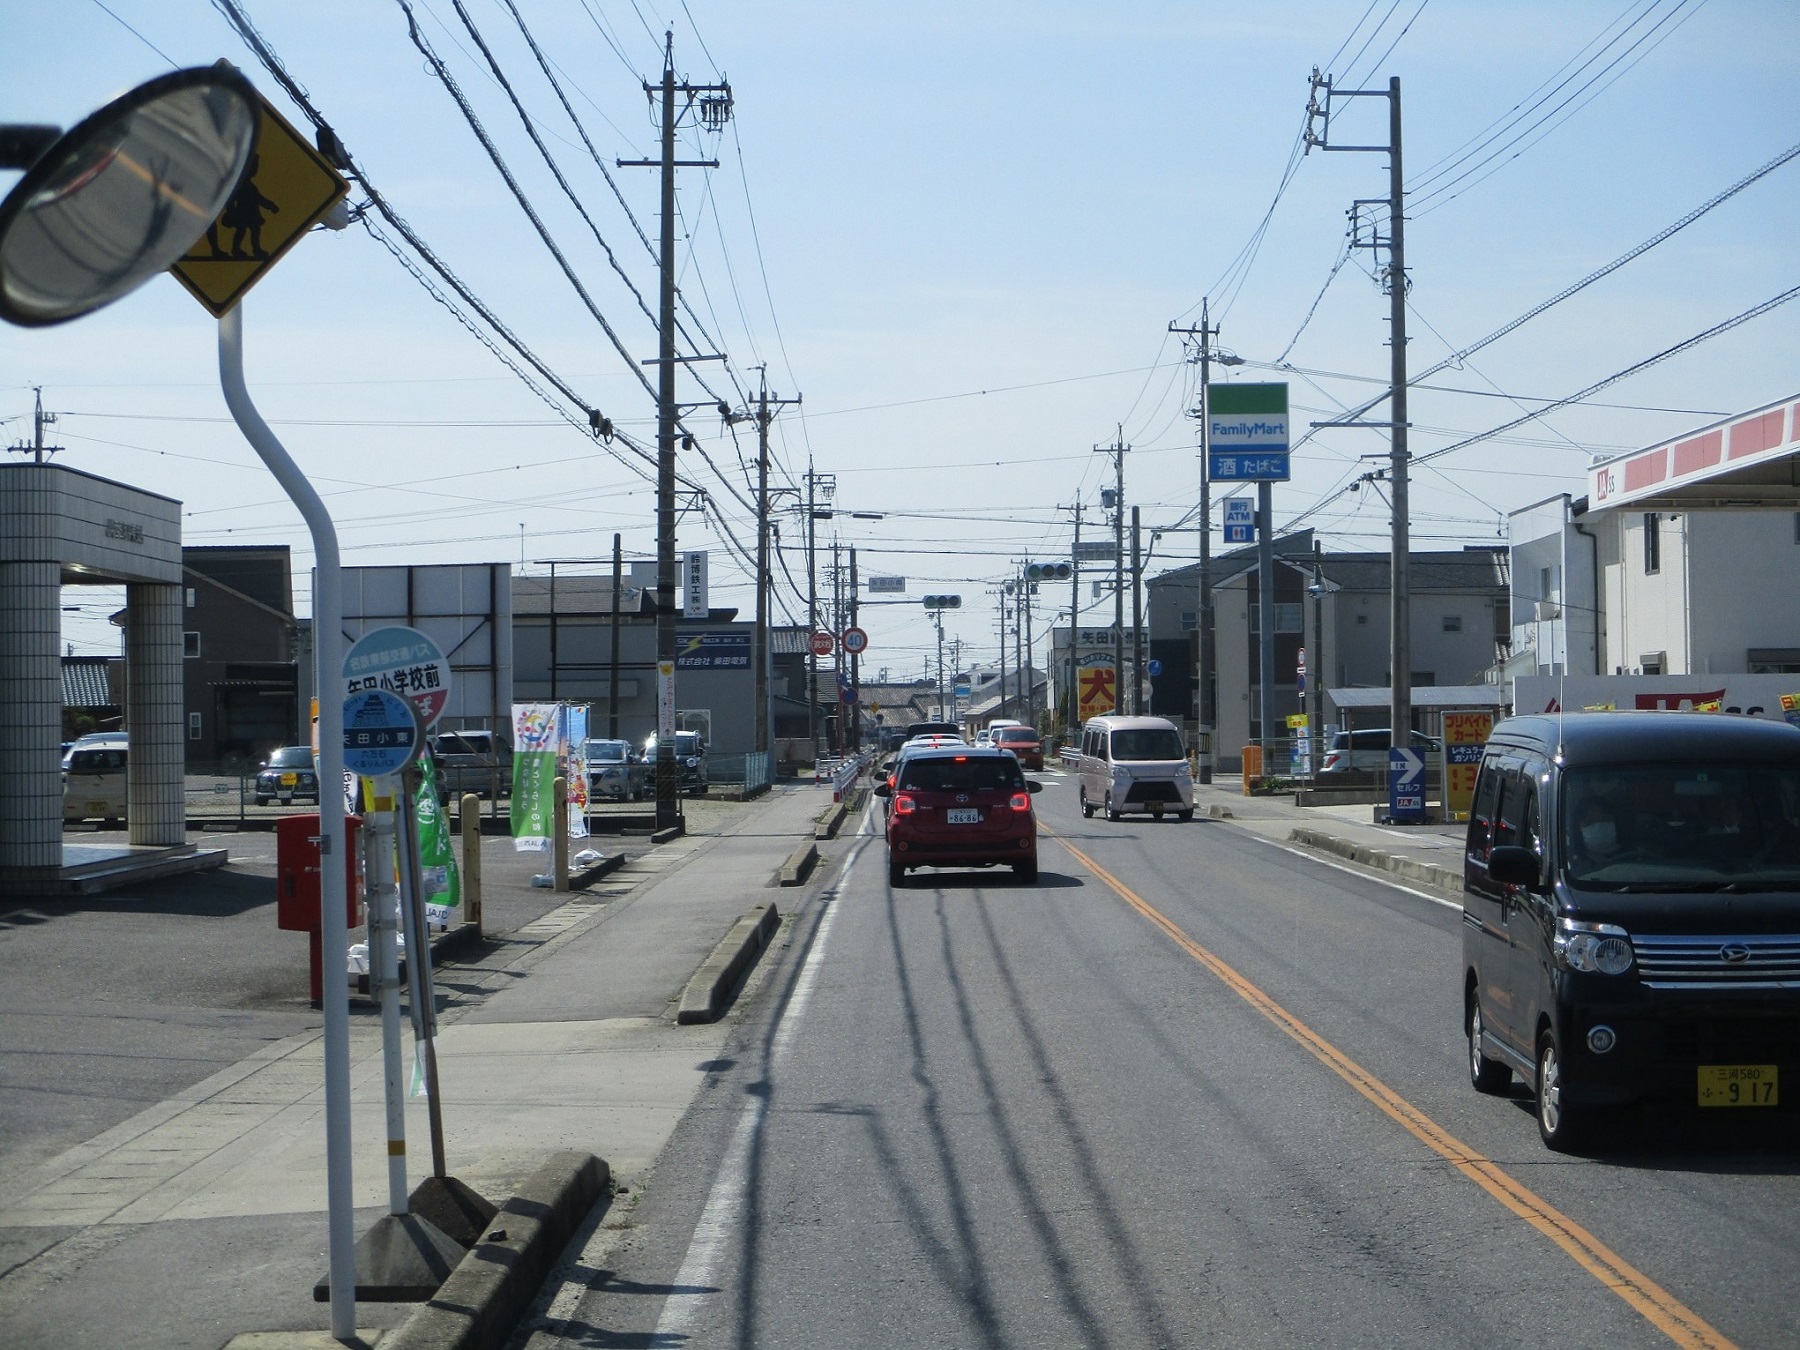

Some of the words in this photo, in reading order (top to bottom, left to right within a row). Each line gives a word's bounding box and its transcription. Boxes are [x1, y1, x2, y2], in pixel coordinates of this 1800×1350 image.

[1212, 423, 1284, 438] FamilyMart
[1218, 458, 1237, 476] 酒
[1243, 459, 1282, 473] たばこ
[1230, 502, 1248, 512] 銀行
[1227, 512, 1250, 522] ATM
[847, 634, 862, 647] 40
[348, 663, 441, 694] 矢田小学校前
[1080, 669, 1116, 704] 犬
[1454, 729, 1483, 742] カード
[1451, 746, 1485, 755] レギュラー
[1396, 784, 1420, 792] セルフ
[1740, 1069, 1760, 1080] 580
